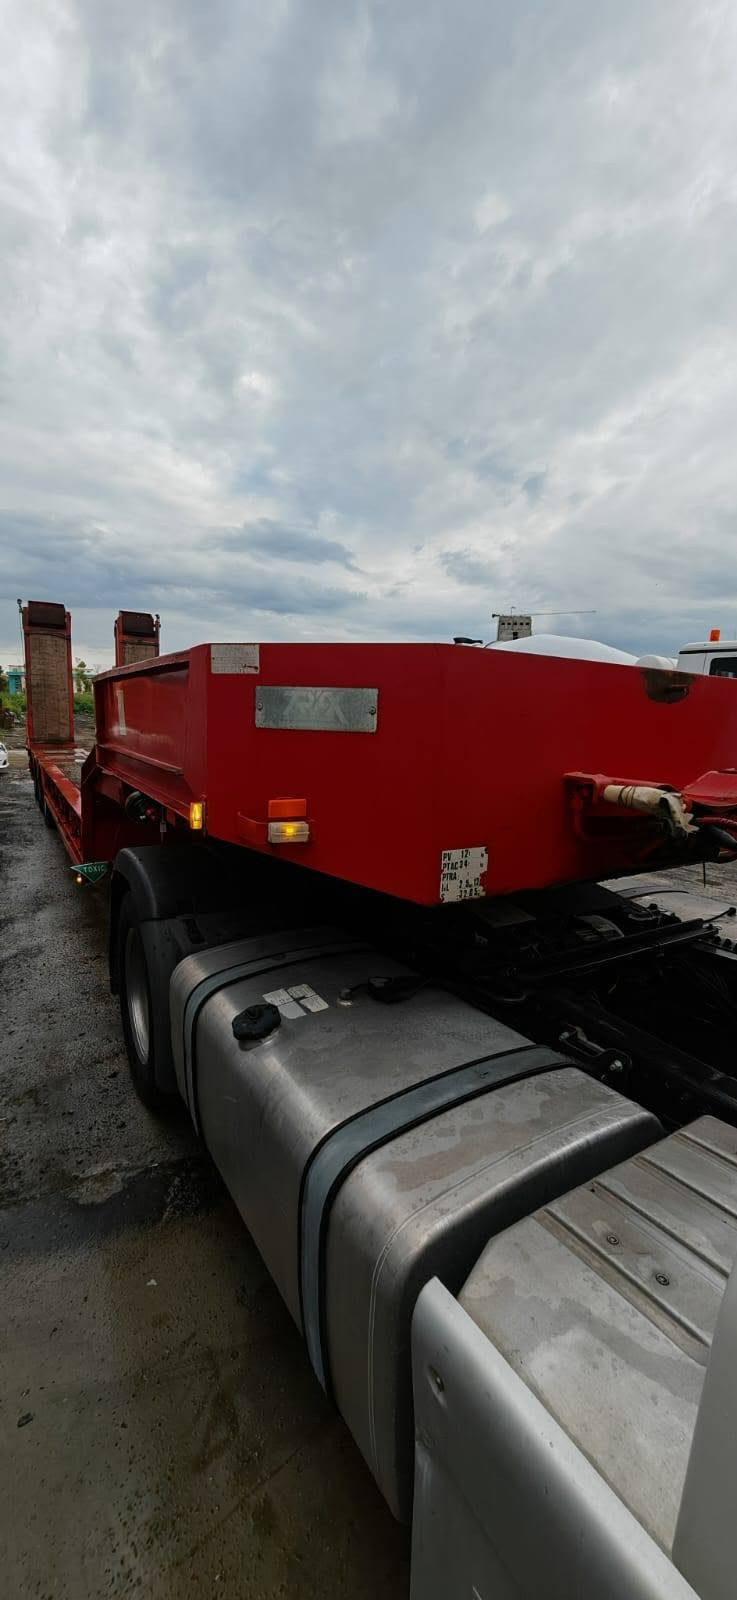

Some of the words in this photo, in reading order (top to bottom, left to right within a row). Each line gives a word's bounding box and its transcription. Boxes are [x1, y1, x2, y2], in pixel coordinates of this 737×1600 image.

[443, 852, 452, 861] PV
[83, 864, 104, 873] TOXIC
[443, 861, 459, 871] PTAC
